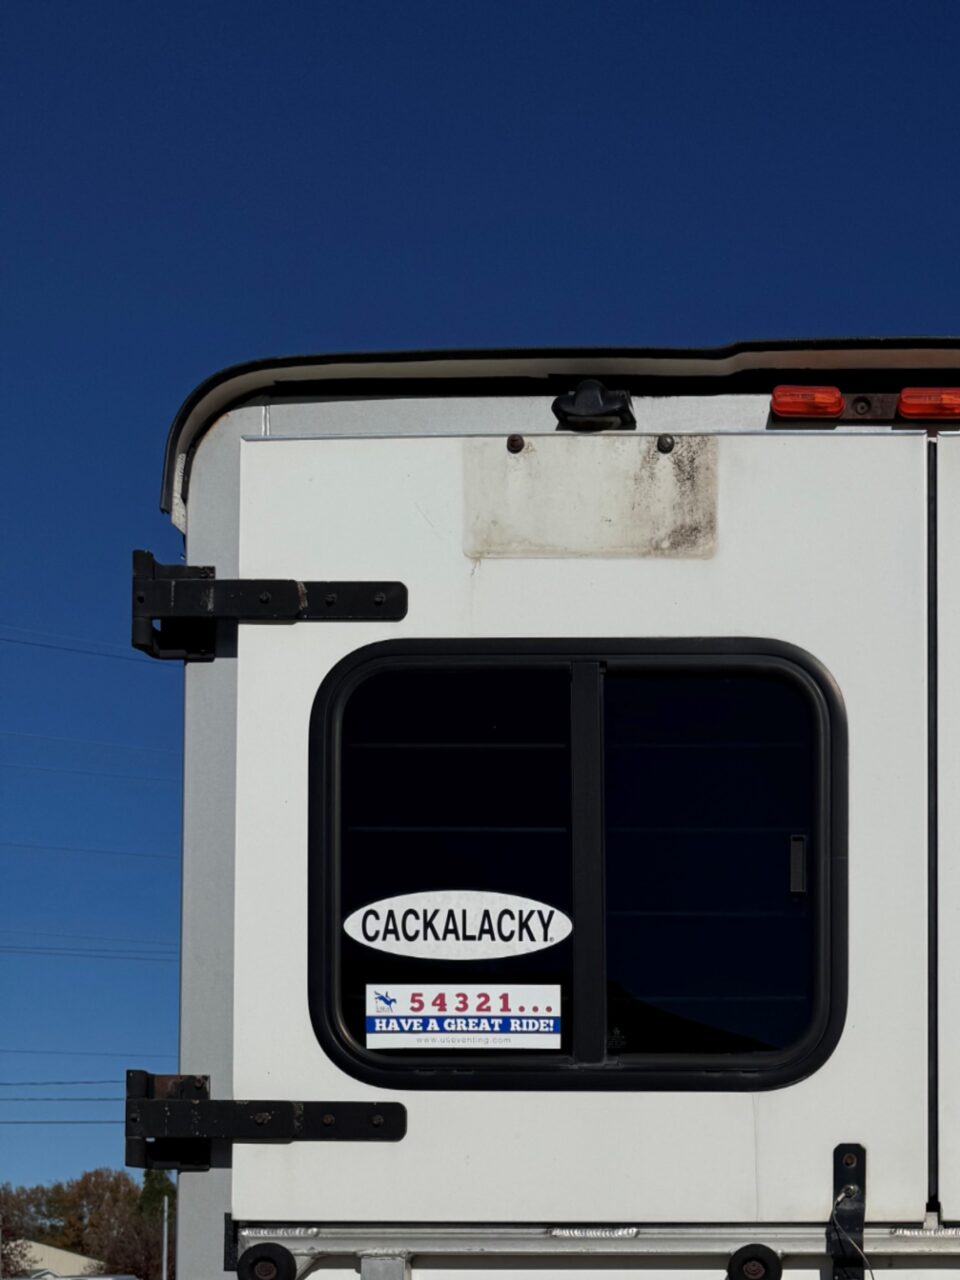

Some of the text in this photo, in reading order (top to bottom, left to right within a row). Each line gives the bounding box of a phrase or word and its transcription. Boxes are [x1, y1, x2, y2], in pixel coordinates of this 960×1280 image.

[361, 908, 555, 942] CACKALACKY
[374, 1018, 555, 1032] HAVE A GREAT RIDE!
